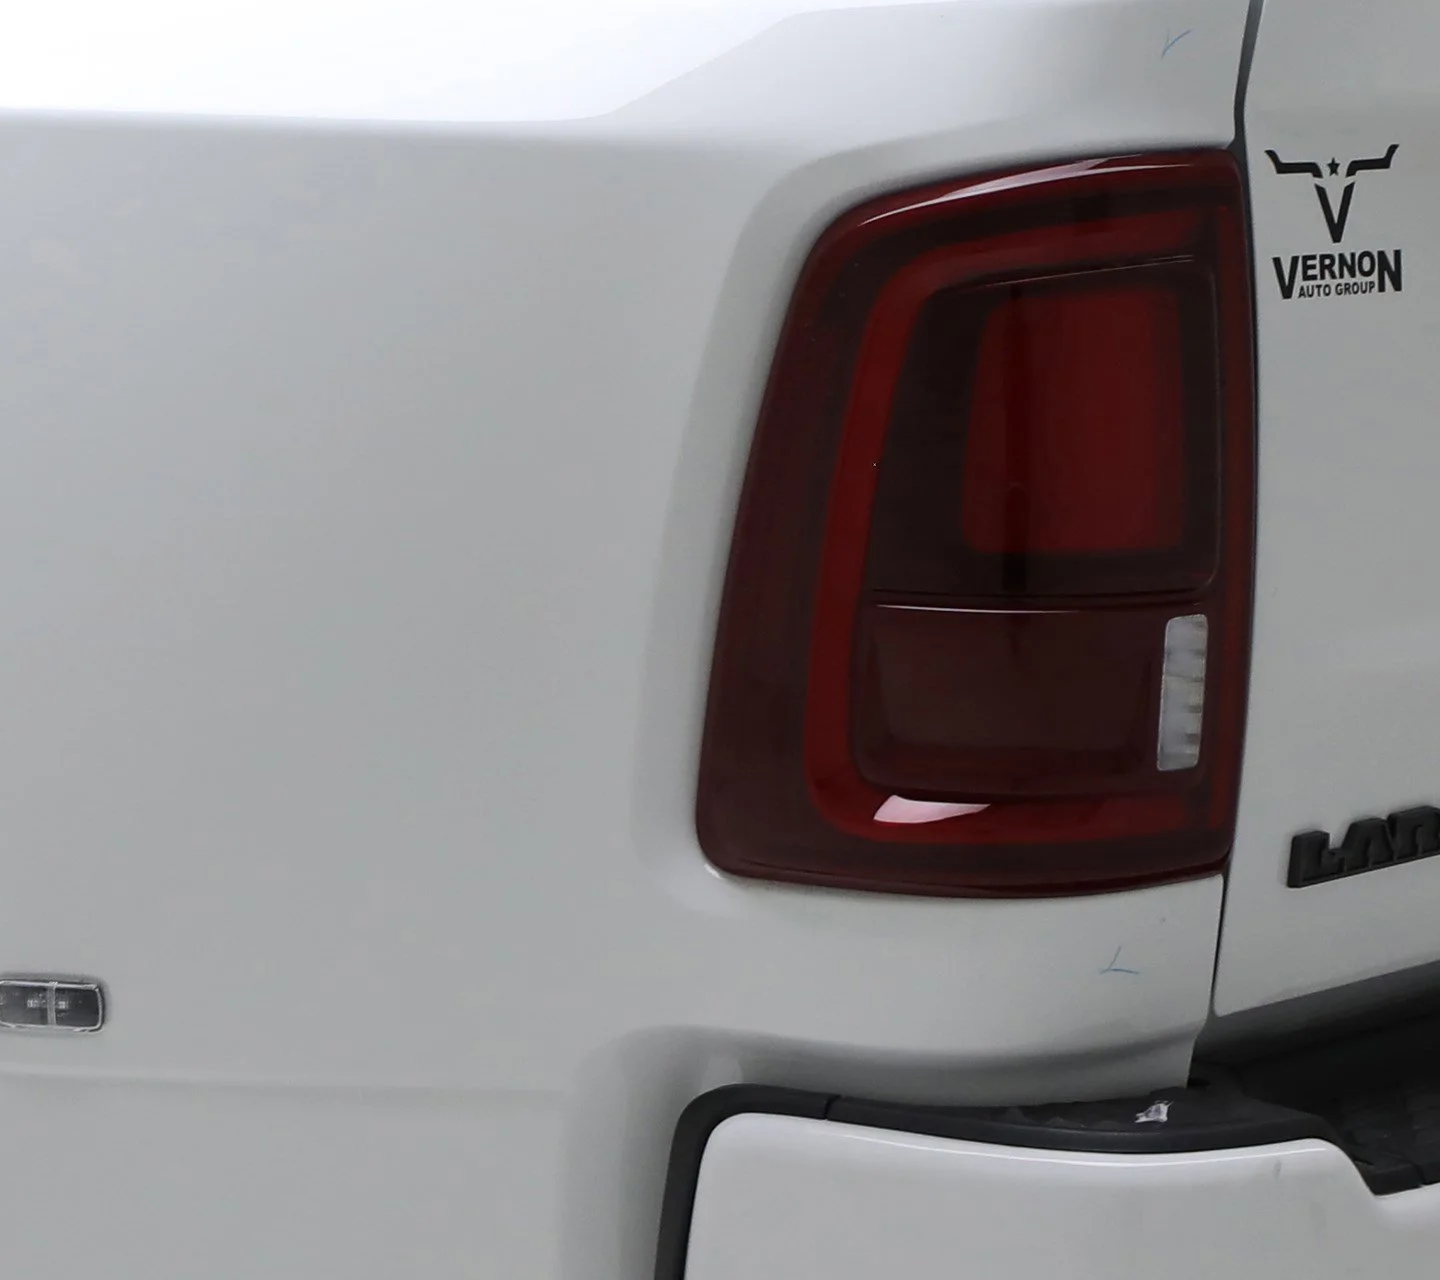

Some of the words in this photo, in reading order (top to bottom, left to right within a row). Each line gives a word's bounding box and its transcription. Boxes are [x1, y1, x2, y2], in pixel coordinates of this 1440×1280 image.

[1272, 249, 1403, 300] VERNON
[1297, 283, 1332, 299] AUTO
[1334, 280, 1376, 296] GROUP
